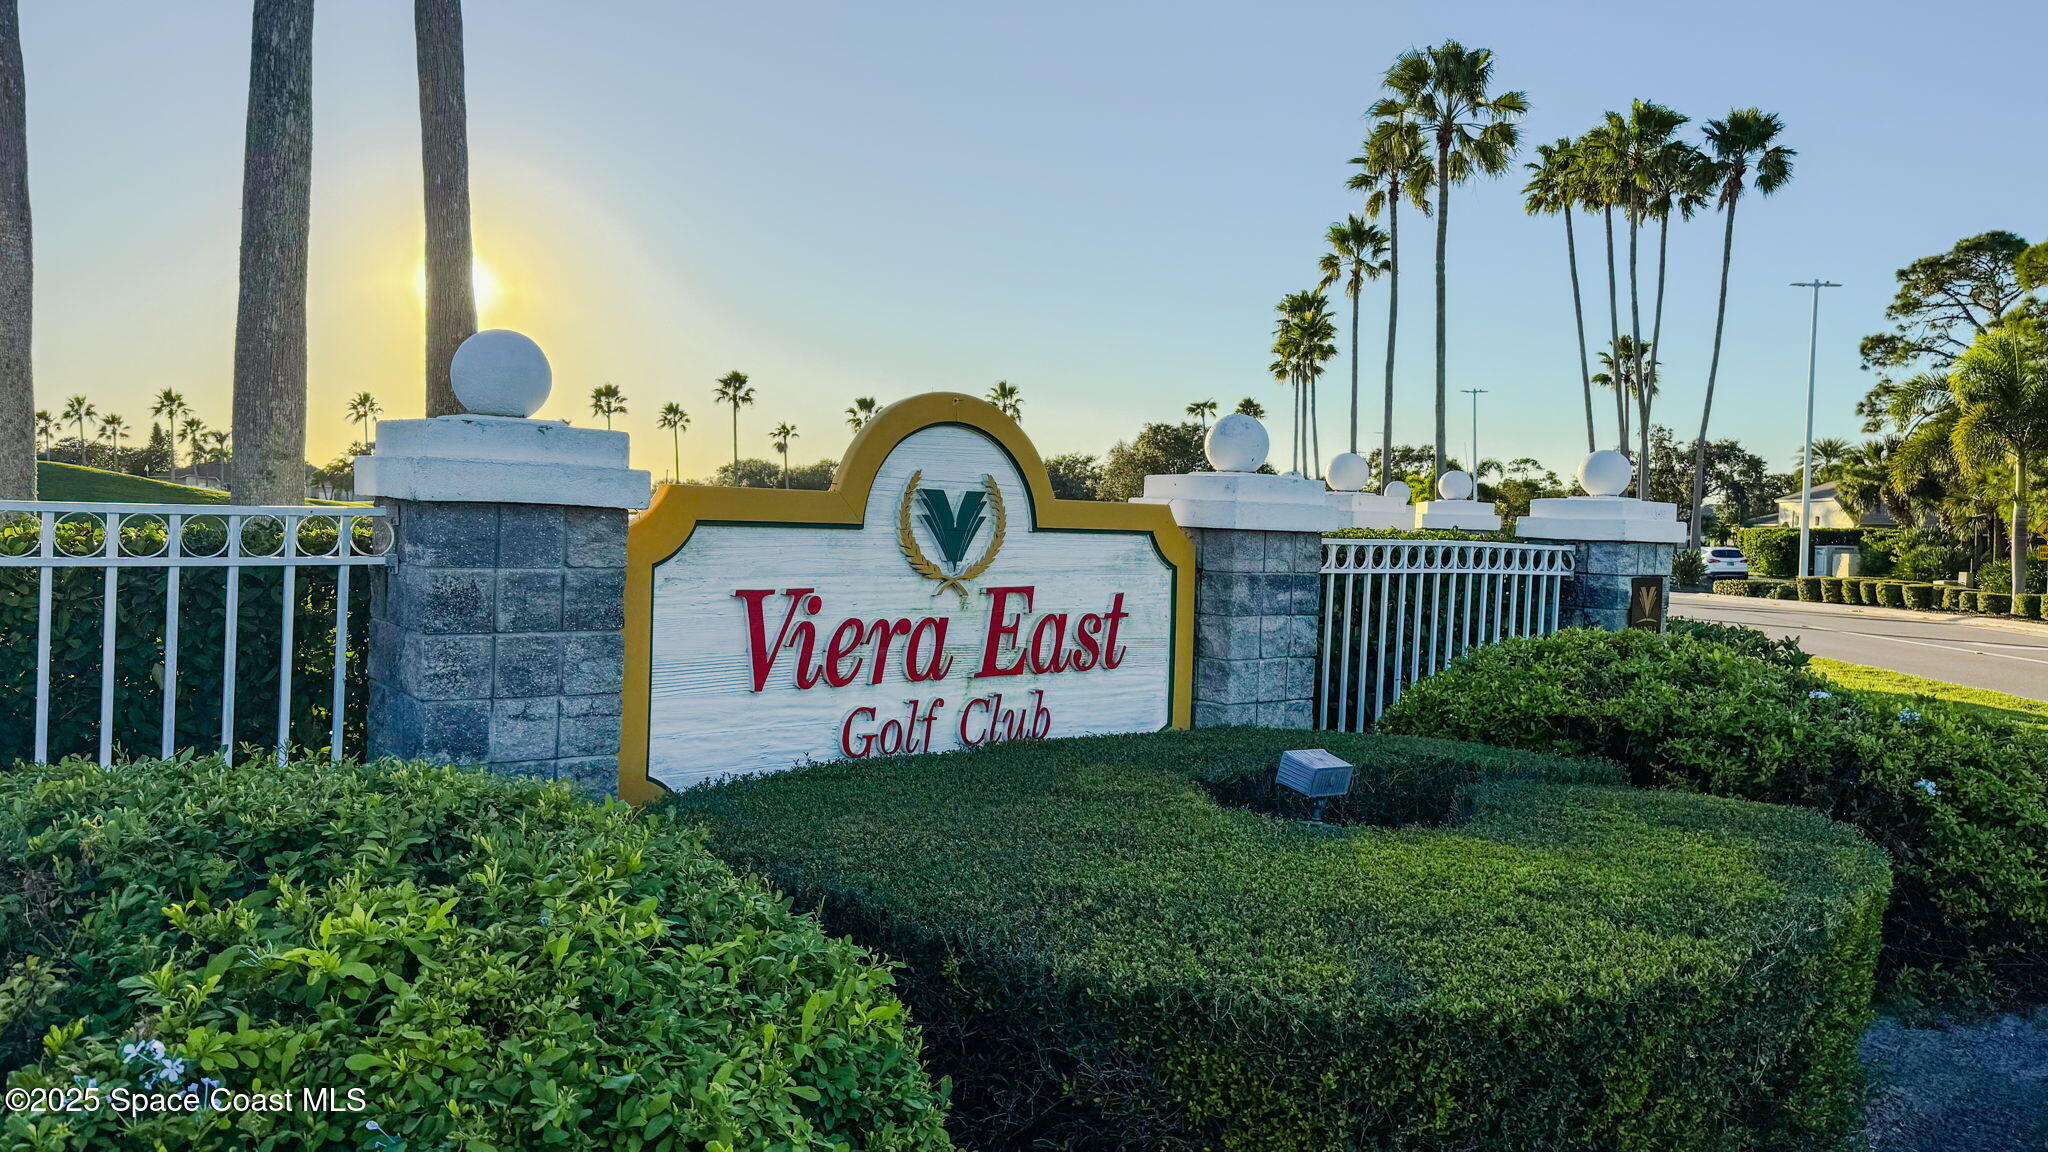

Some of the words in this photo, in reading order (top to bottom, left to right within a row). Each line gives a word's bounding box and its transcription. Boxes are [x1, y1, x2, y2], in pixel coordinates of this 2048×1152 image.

[733, 587, 955, 693] Viera
[972, 585, 1130, 679] East
[841, 697, 945, 758] Golf
[959, 689, 1051, 746] Club
